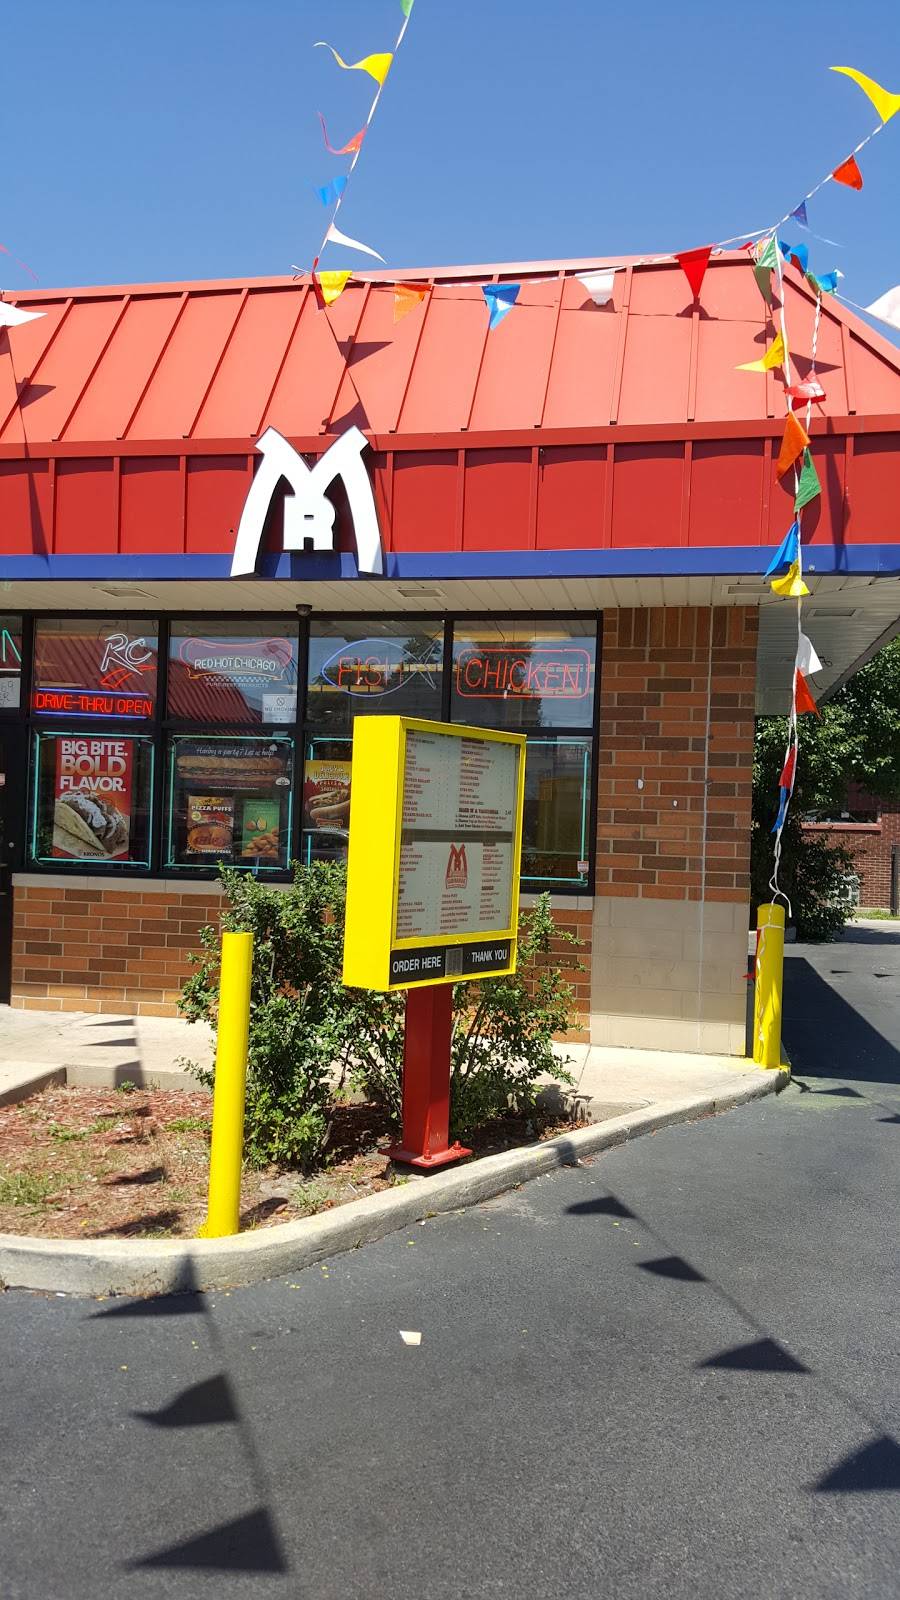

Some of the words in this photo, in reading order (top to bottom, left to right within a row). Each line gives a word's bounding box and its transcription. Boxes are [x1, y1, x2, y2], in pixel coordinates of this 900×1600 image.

[100, 633, 153, 676] RC
[194, 659, 213, 669] RED
[214, 657, 233, 668] HOT
[234, 658, 276, 671] CHICAGO
[465, 658, 580, 692] CHICKEN
[35, 693, 112, 713] DRIVE-THRU
[116, 699, 153, 716] OPEN
[61, 740, 88, 755] BIG
[90, 741, 128, 756] BITE.
[61, 755, 127, 776] BOLD
[60, 776, 127, 792] FLAVOR.
[392, 960, 419, 973] ORDER
[421, 955, 442, 968] HERE
[471, 951, 493, 963] THANK
[494, 948, 507, 960] YOU
